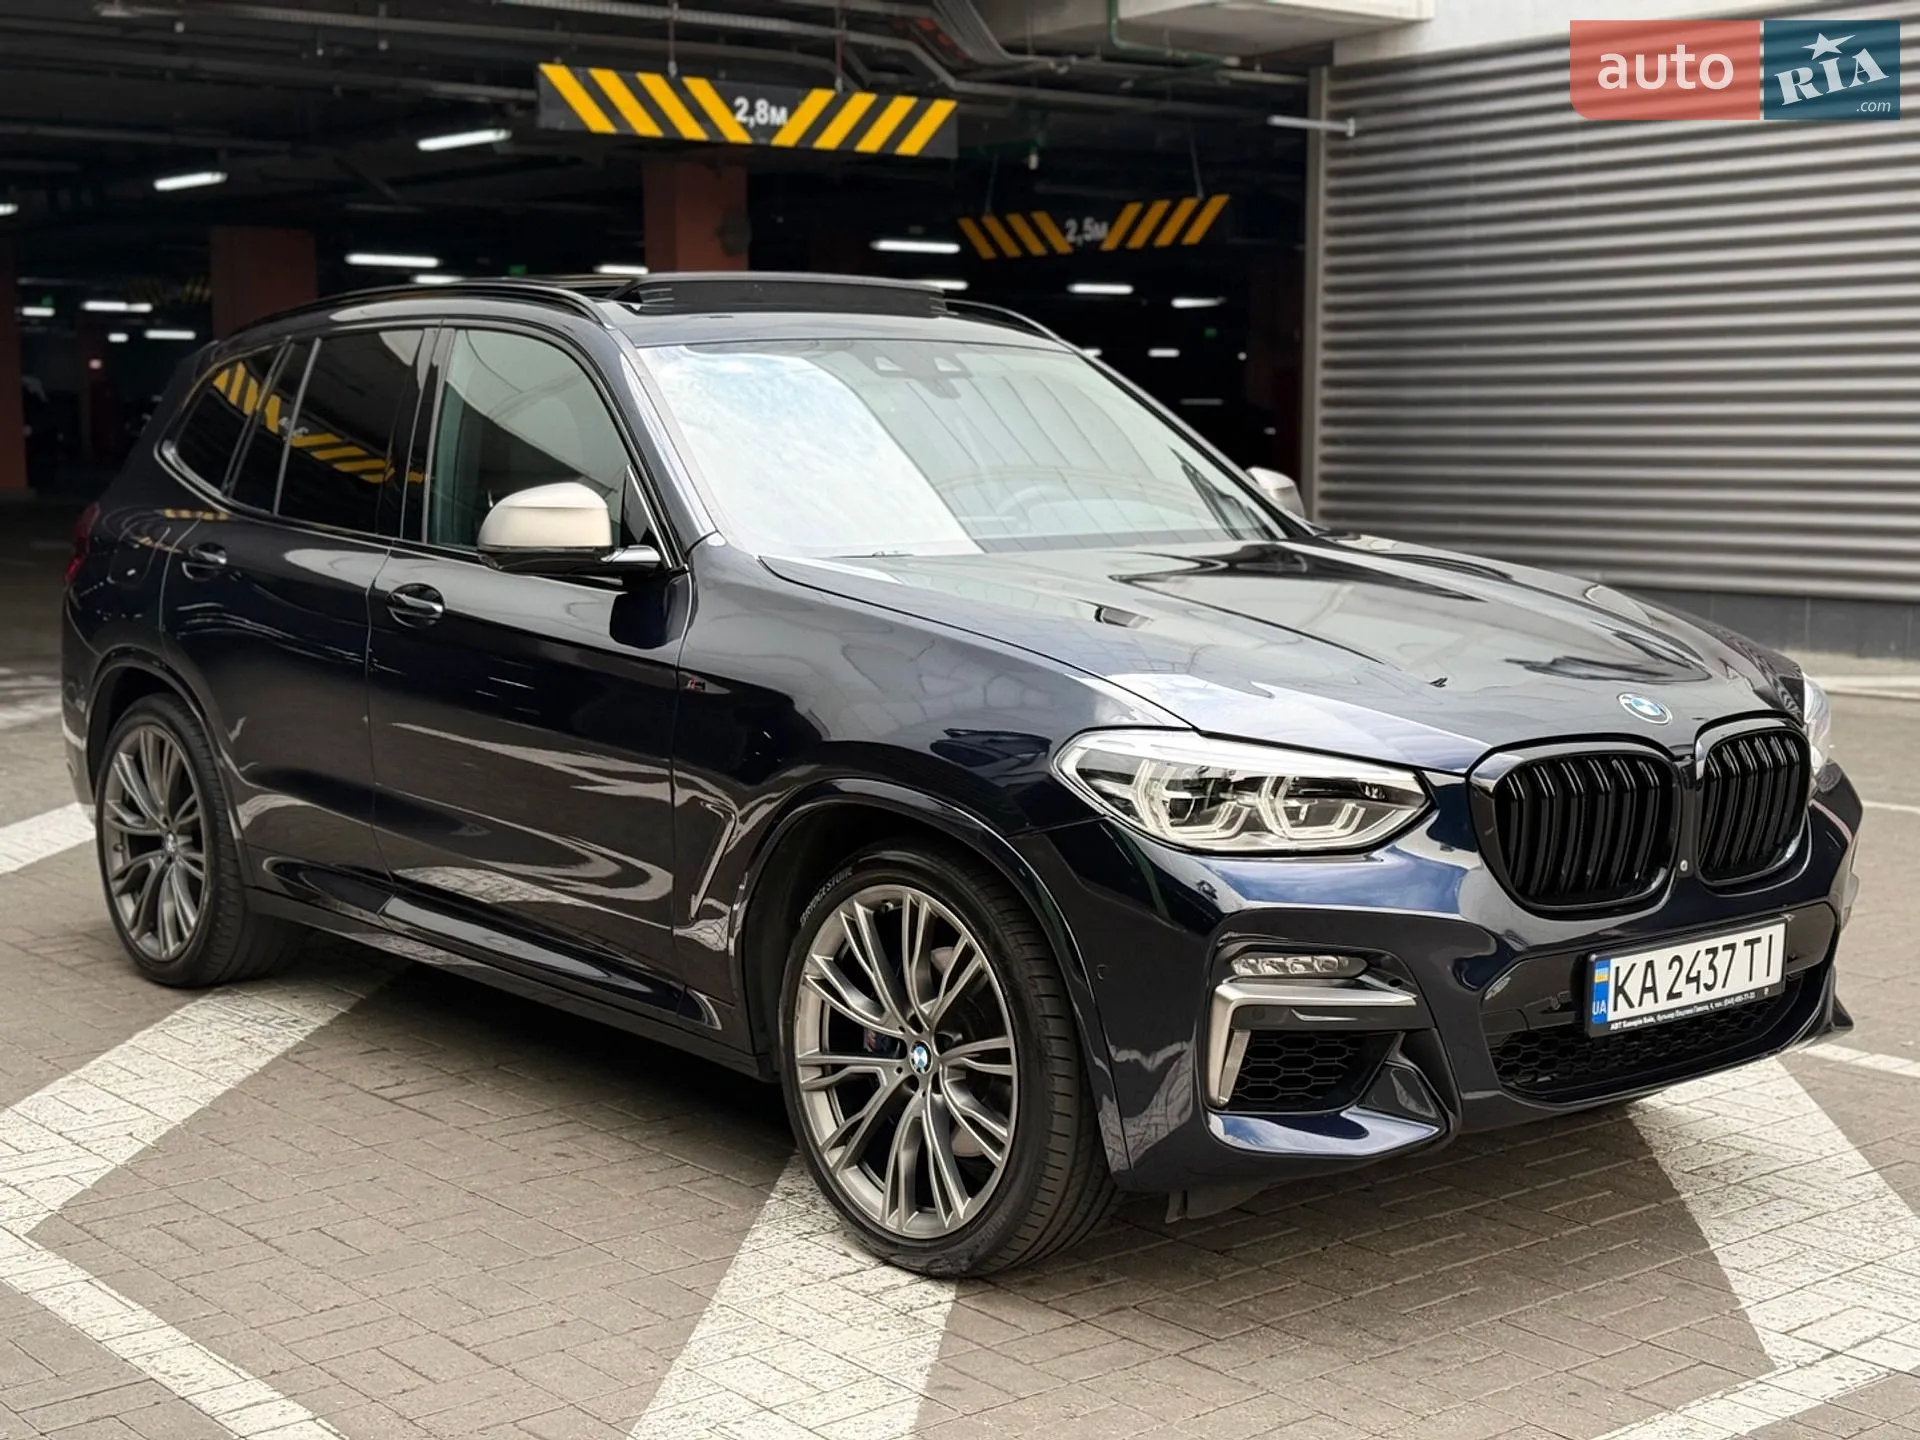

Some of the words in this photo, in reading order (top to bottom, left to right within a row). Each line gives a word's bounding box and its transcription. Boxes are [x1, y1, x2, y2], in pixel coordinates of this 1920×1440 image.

[1613, 959, 1658, 1012] KA
[1666, 942, 1737, 1001] 2437
[1744, 934, 1773, 982] TI
[1592, 1001, 1607, 1015] UA
